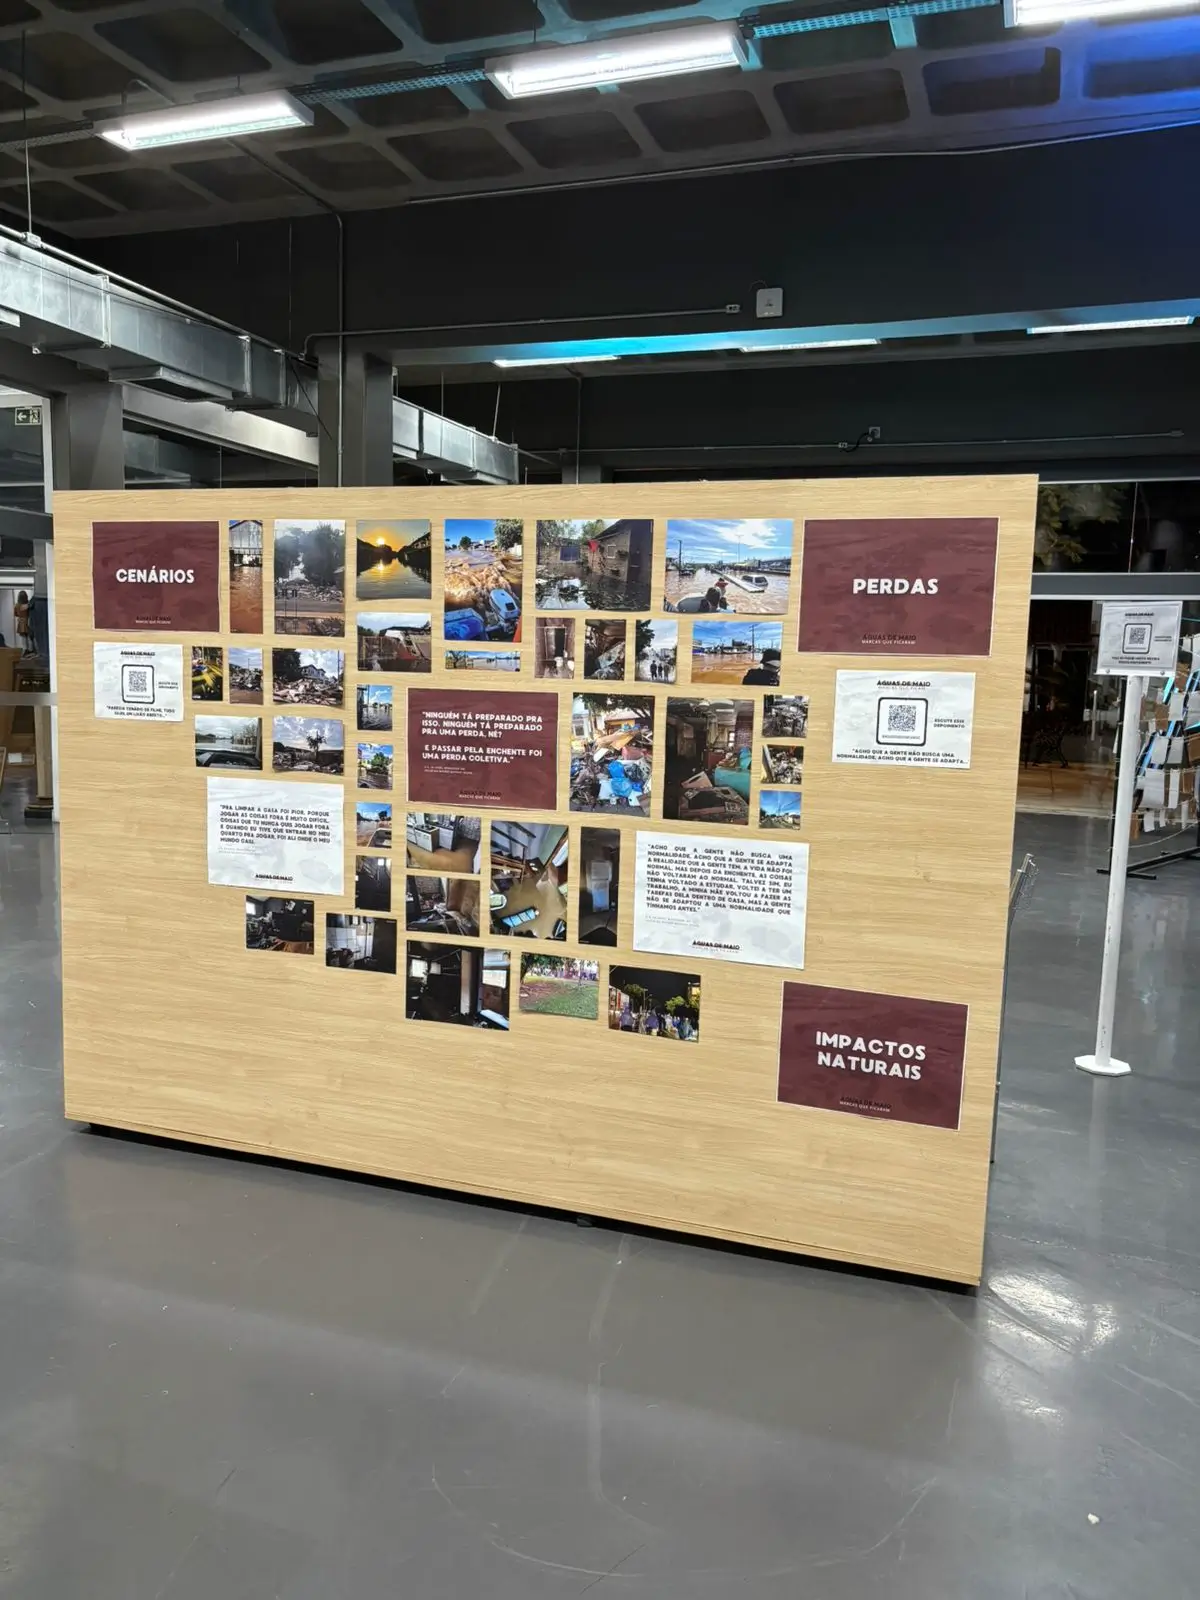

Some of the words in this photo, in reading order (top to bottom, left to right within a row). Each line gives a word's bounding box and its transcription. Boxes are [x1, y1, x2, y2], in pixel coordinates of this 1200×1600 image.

[116, 565, 195, 583] CENÁRIOS
[853, 578, 939, 595] PERDAS
[475, 714, 523, 722] PREPARADO
[443, 720, 477, 729] NINGUÉM
[493, 723, 542, 731] PREPARADO
[488, 730, 502, 738] NÉ?
[432, 745, 461, 753] PASSAR
[487, 748, 526, 756] ENCHENTE
[729, 904, 774, 913] NORMALIDADE
[816, 1031, 926, 1061] IMPACTOS
[818, 1051, 922, 1081] NATURAIS
